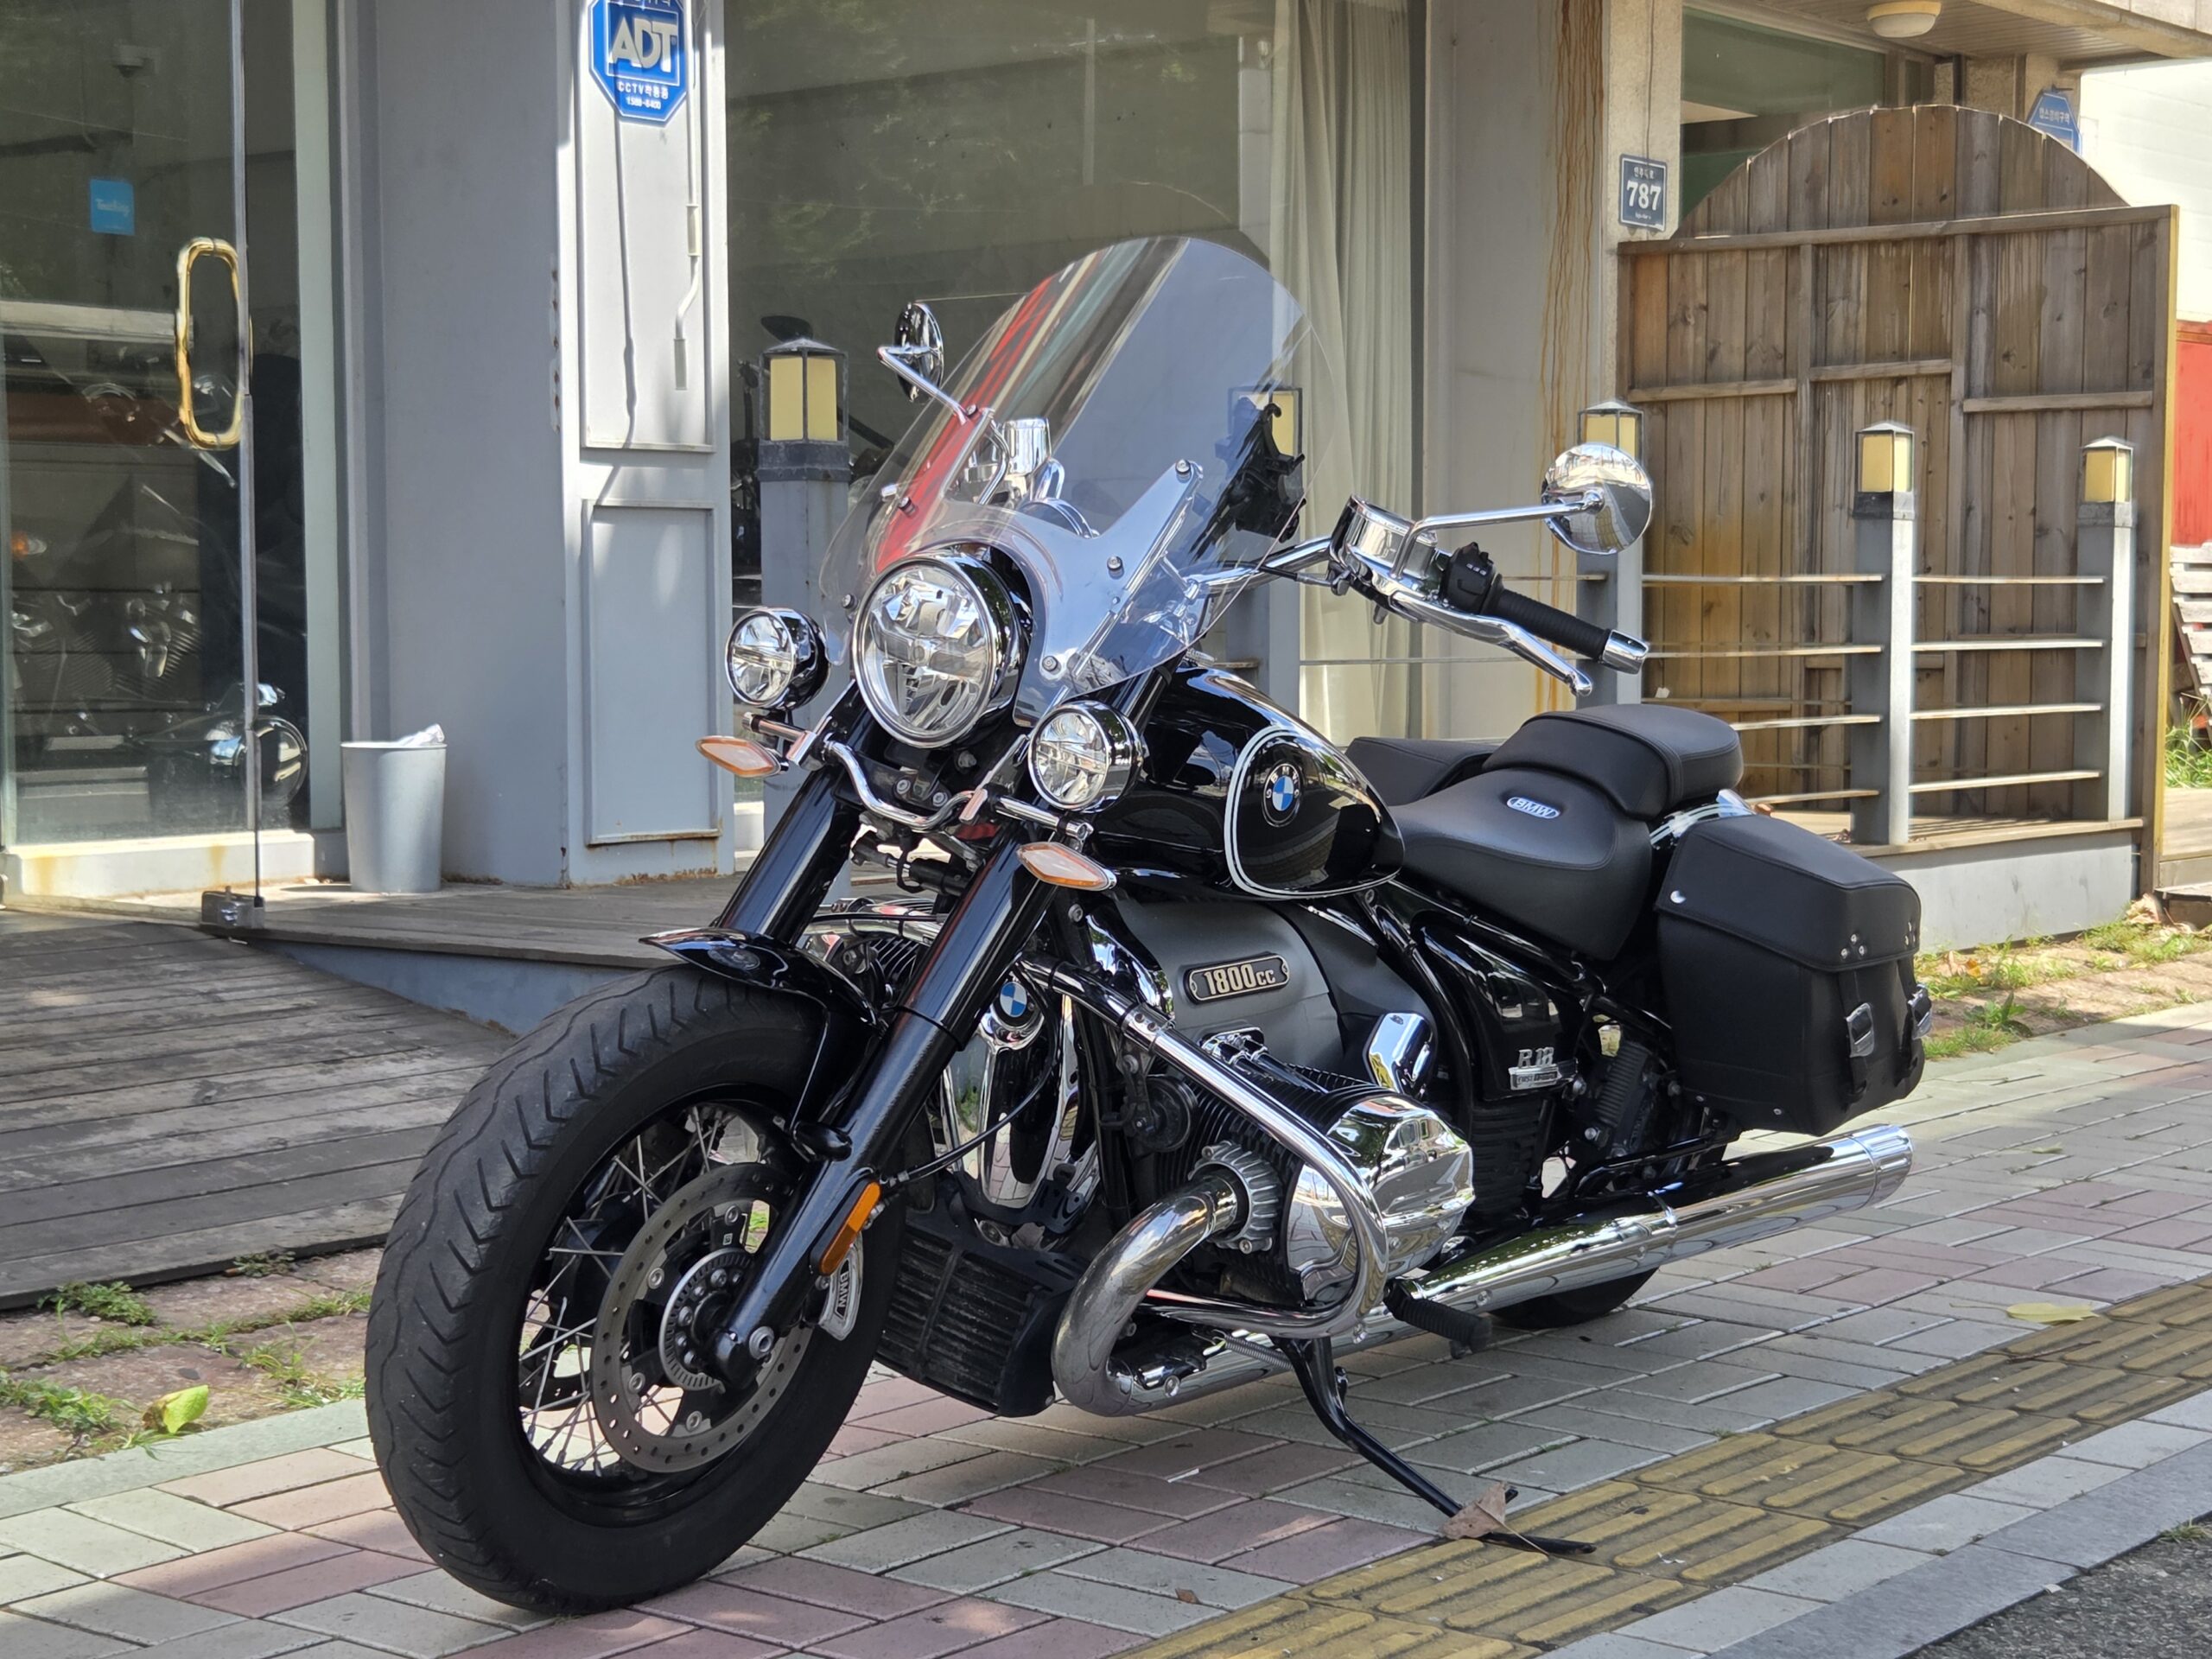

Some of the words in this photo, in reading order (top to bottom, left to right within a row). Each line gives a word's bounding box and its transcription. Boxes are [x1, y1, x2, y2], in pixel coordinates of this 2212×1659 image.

[608, 16, 678, 73] ADT
[1626, 180, 1662, 211] 787
[1512, 798, 1553, 817] BMW
[1517, 1048, 1533, 1069] R
[839, 1271, 849, 1308] BMW
